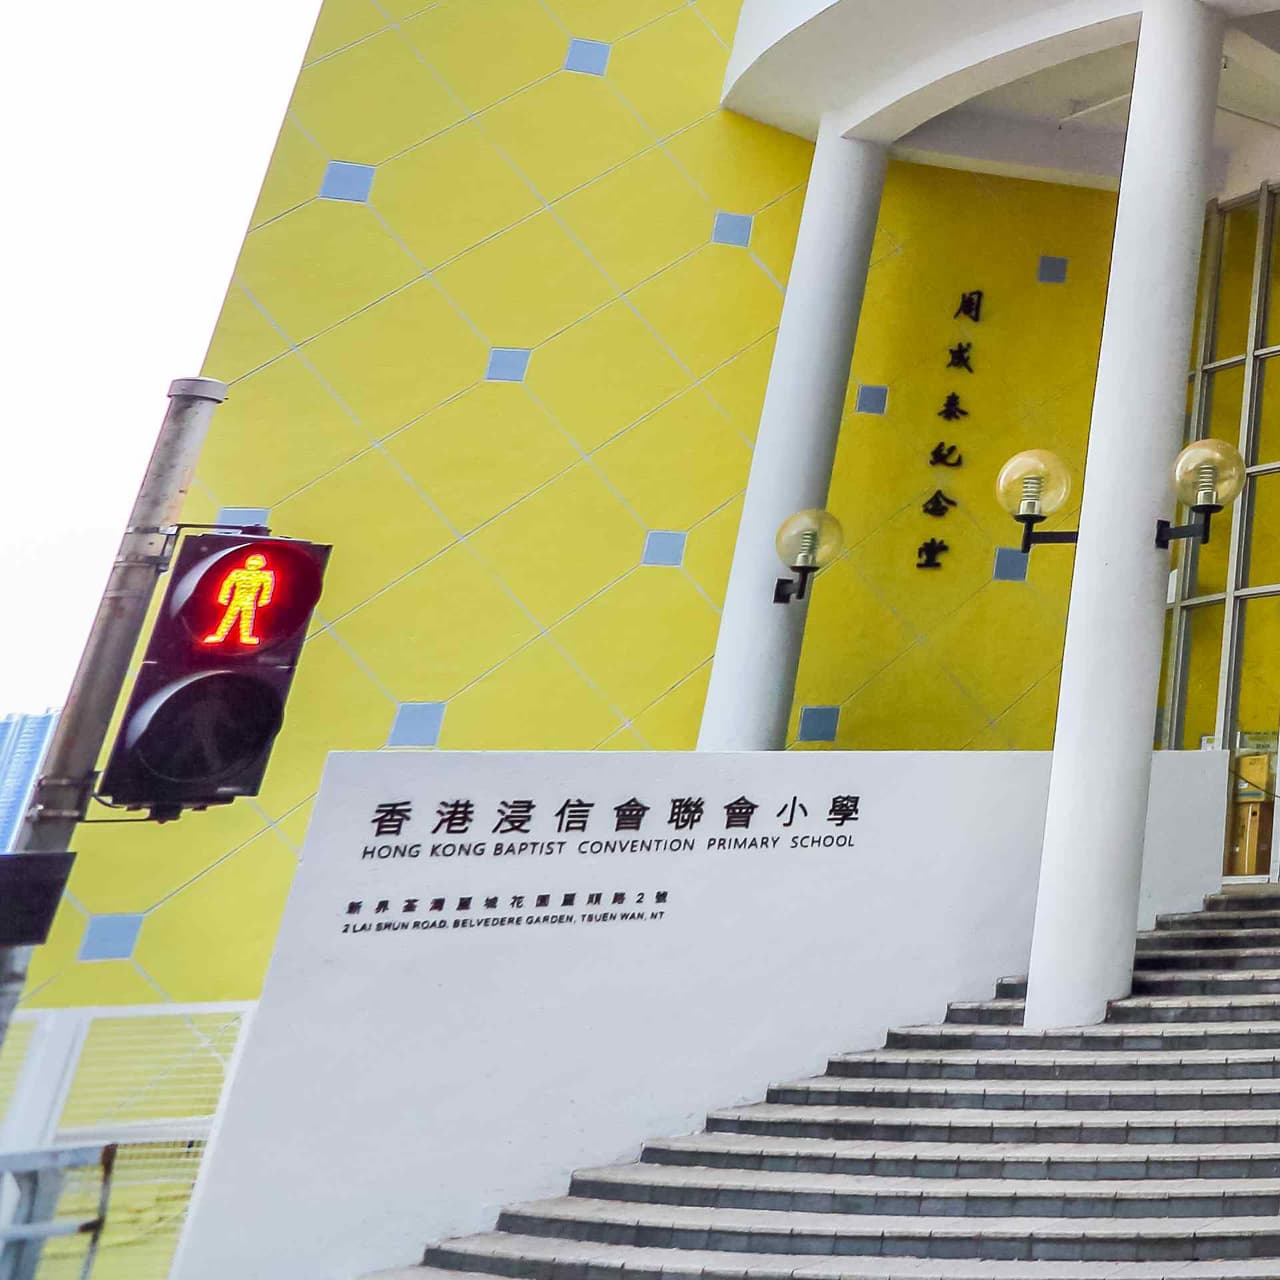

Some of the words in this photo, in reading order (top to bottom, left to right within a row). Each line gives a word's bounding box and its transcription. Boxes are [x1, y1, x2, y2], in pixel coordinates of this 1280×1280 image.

[370, 794, 860, 837] 香港浸信會聯會小學
[362, 843, 421, 860] HONG
[429, 841, 486, 857] KONG
[492, 840, 567, 856] BAPTIST
[577, 837, 696, 855] CONVENTION
[706, 836, 781, 851] PRIMARY
[790, 834, 855, 849] SCHOOL
[342, 924, 349, 934] 2
[352, 923, 372, 933] LAI
[375, 921, 410, 932] SHUN
[452, 916, 523, 929] BELVEDERE
[581, 912, 618, 923] TSUEN
[650, 911, 665, 920] NT
